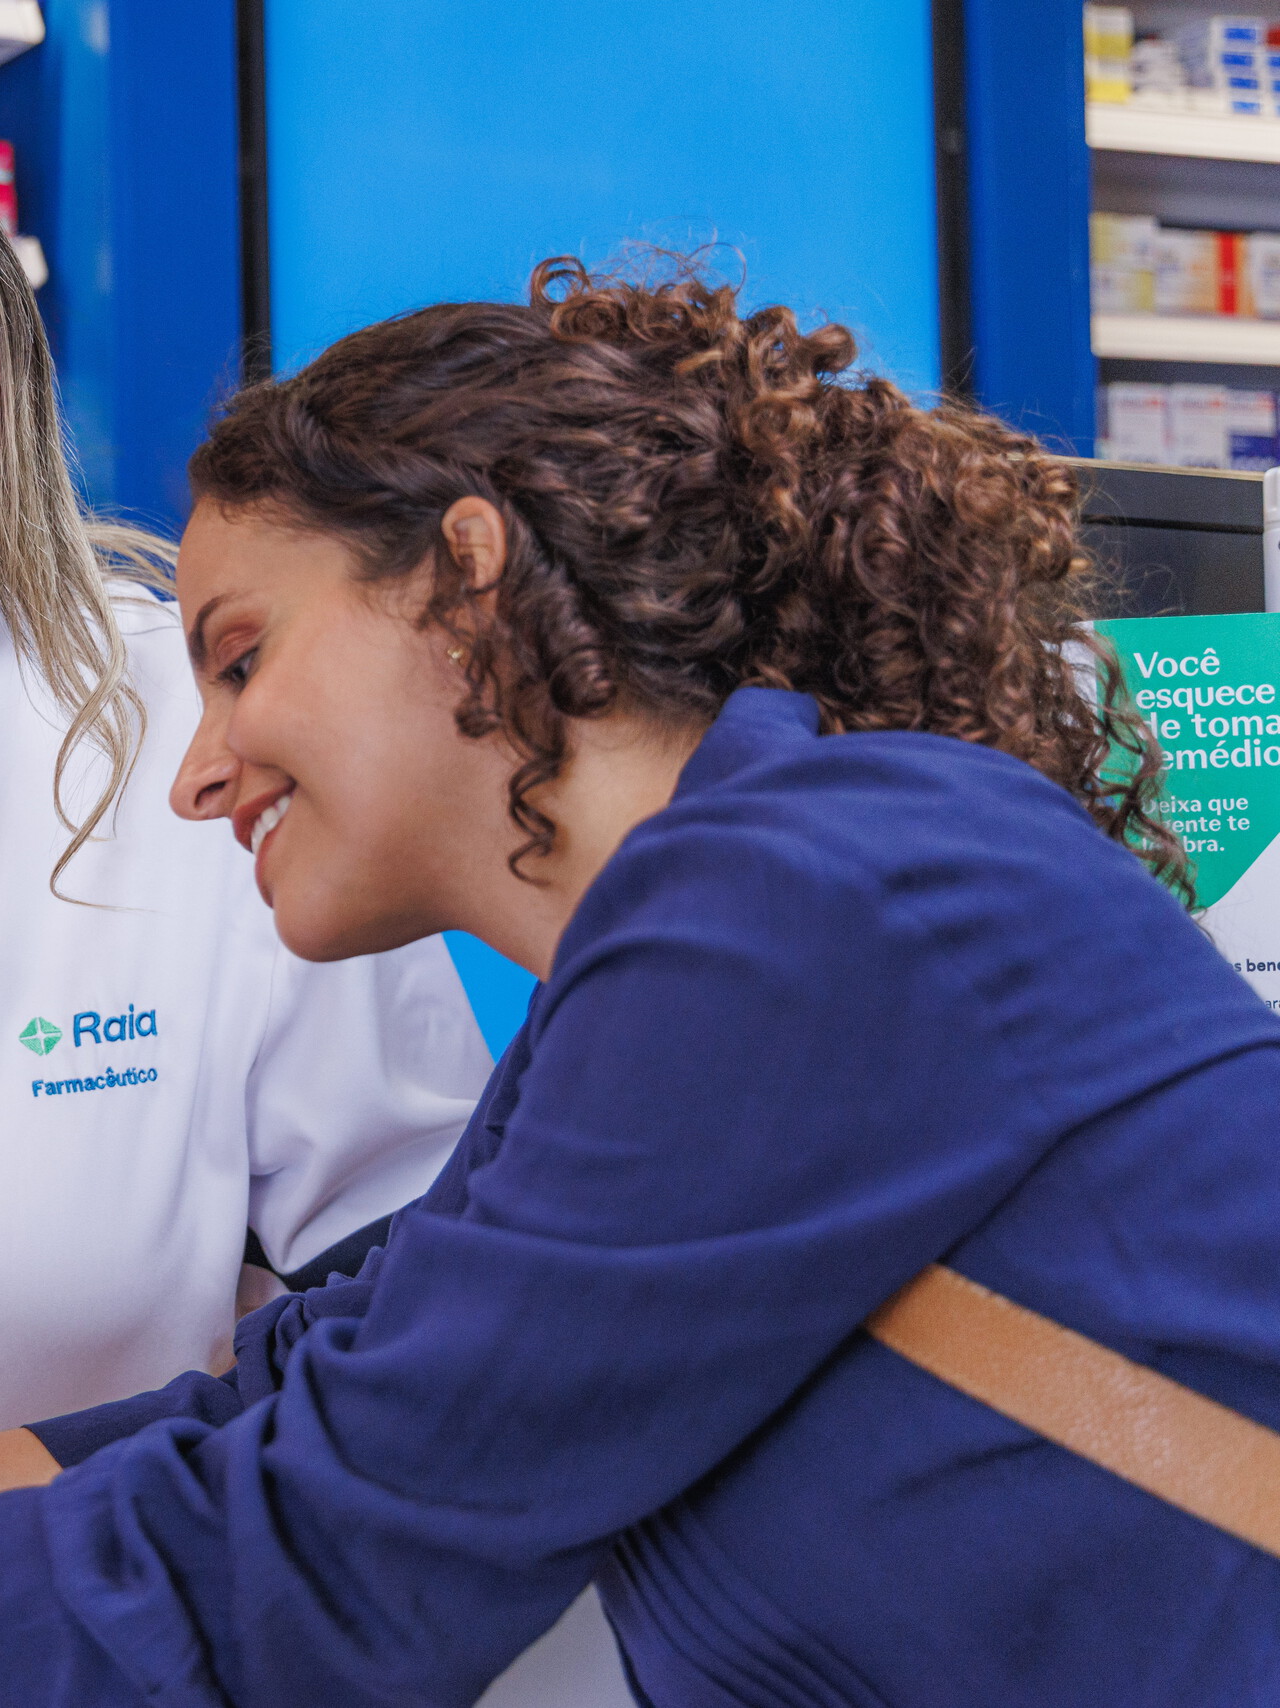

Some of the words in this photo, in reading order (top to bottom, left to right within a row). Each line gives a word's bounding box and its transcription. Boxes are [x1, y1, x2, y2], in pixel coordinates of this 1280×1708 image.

[1133, 648, 1220, 678] Você
[1136, 684, 1276, 715] esquece
[1141, 739, 1280, 770] emédio
[1208, 798, 1249, 816] que
[1227, 816, 1250, 831] te
[1246, 958, 1280, 972] ben
[73, 1003, 158, 1047] Raia
[32, 1066, 158, 1097] Farmacêutico
